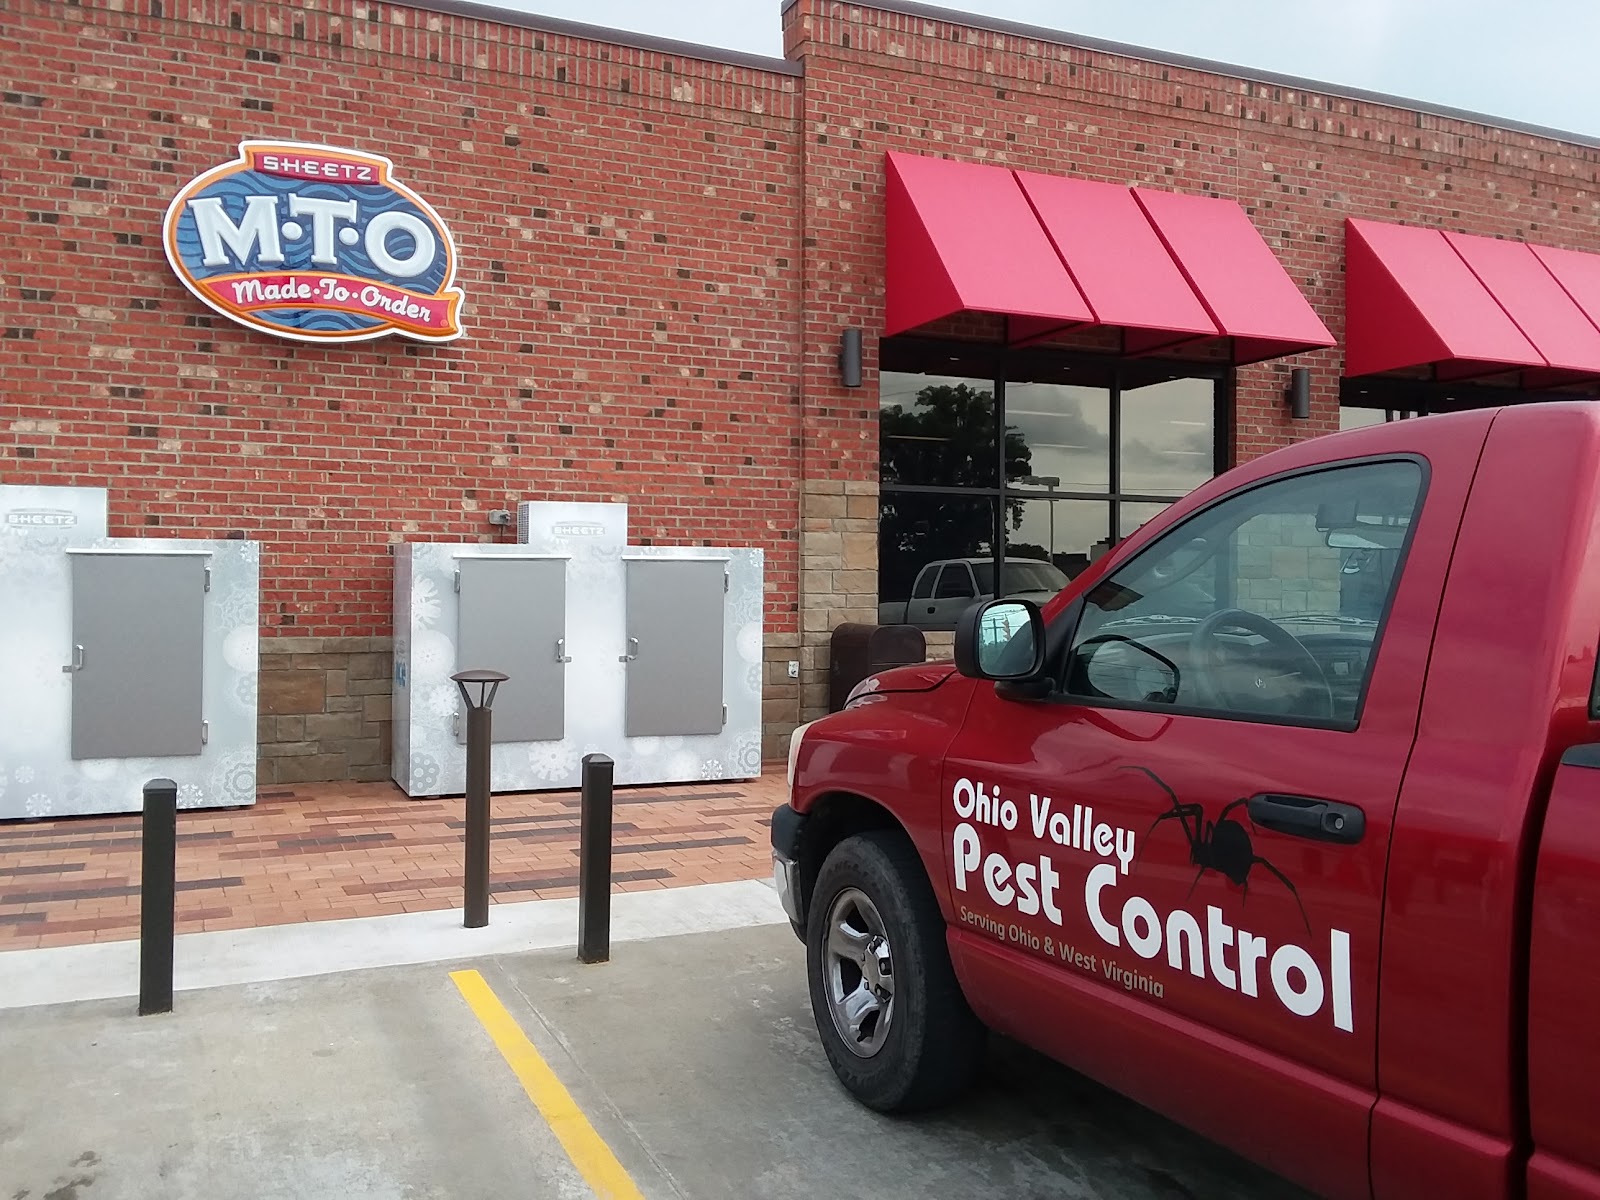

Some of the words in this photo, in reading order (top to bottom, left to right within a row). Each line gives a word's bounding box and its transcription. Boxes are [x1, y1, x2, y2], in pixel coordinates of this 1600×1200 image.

[263, 155, 372, 181] SHEETZ
[8, 514, 75, 524] SHEETZ
[553, 526, 604, 535] SHEETZ
[952, 778, 1018, 831] Ohio
[1030, 793, 1135, 876] Valley
[953, 822, 1063, 926] Pest
[1084, 863, 1354, 1034] Control
[960, 905, 1005, 941] Serving
[1008, 924, 1040, 950] Ohio
[1043, 936, 1055, 957] &
[1058, 941, 1097, 972] West
[1102, 958, 1164, 999] Virginia
